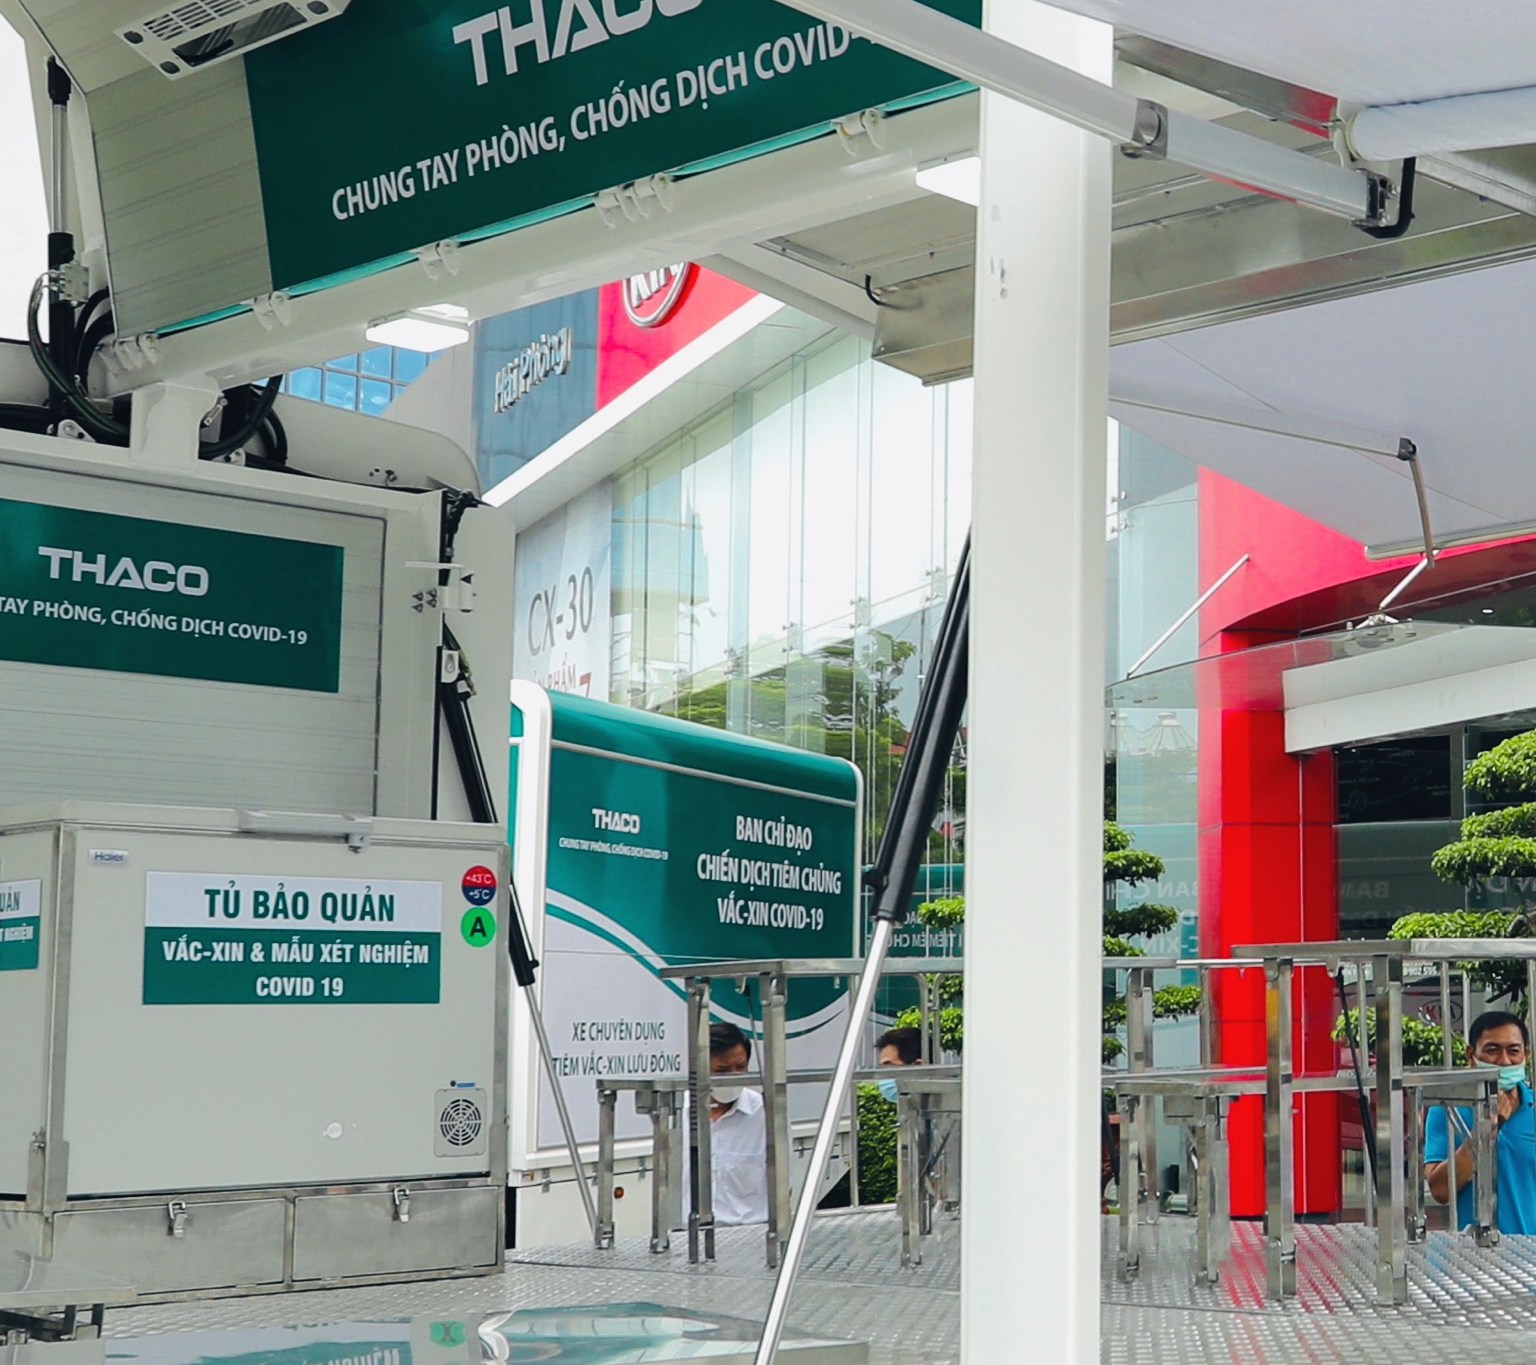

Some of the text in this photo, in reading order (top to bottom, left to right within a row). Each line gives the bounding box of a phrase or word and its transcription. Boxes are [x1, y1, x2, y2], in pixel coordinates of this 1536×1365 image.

[332, 21, 876, 220] CHUNG TAY PHÒNG, CHỐNG DỊCH COVID-
[38, 546, 209, 596] THACO
[32, 600, 107, 625] PHÒNG,
[110, 608, 177, 631] CHỐNG
[181, 617, 224, 638] DỊCH
[228, 623, 308, 645] COVID-19
[528, 566, 593, 656] CX-30
[592, 808, 640, 834] THACO
[736, 815, 813, 855] BAN CHỈ ĐẠO
[94, 851, 125, 863] Haier
[697, 848, 842, 894] CHIẾN DỊCH TIÊM CHỦNG
[204, 880, 395, 924] TỦ BẢO QUẢN
[717, 890, 823, 931] VẮC-XIN COVID-19
[469, 916, 488, 938] A
[162, 934, 429, 968] VẮC-XIN & MẪU XÉT NGHIỆM
[256, 976, 344, 997] COVID 19
[572, 1018, 665, 1046] XE CHUYÊN DỤNG
[552, 1053, 579, 1077] TIÊM
[582, 1049, 625, 1075] VẮC-XIN
[628, 1053, 648, 1074] LƯU
